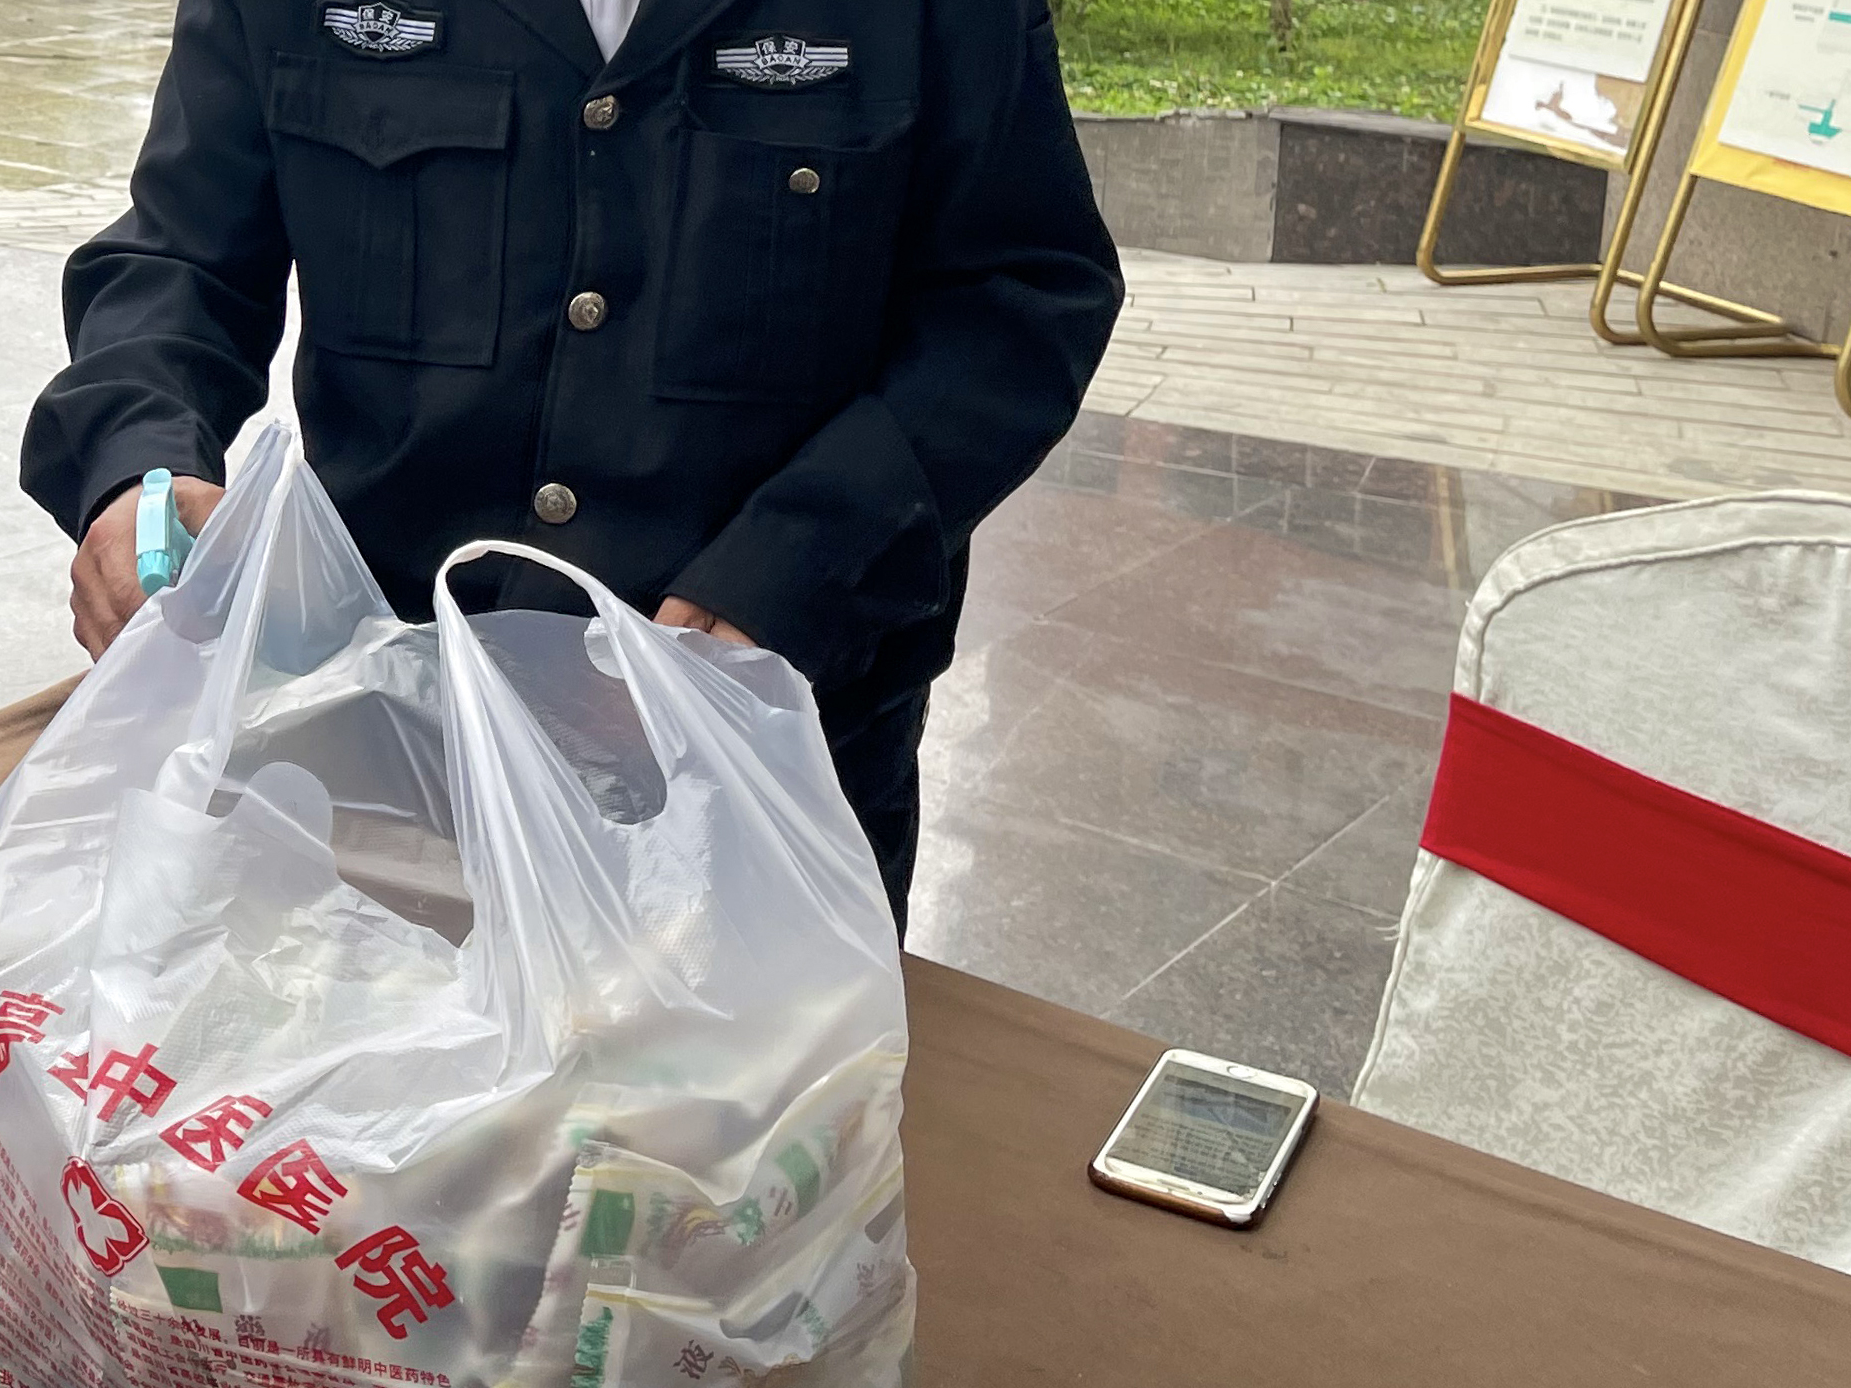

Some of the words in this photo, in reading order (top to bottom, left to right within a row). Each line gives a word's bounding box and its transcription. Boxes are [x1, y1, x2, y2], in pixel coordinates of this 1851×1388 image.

[362, 8, 394, 24] 保安
[358, 22, 394, 34] BAOAN
[761, 40, 799, 55] 保安
[759, 54, 801, 66] BAOAN
